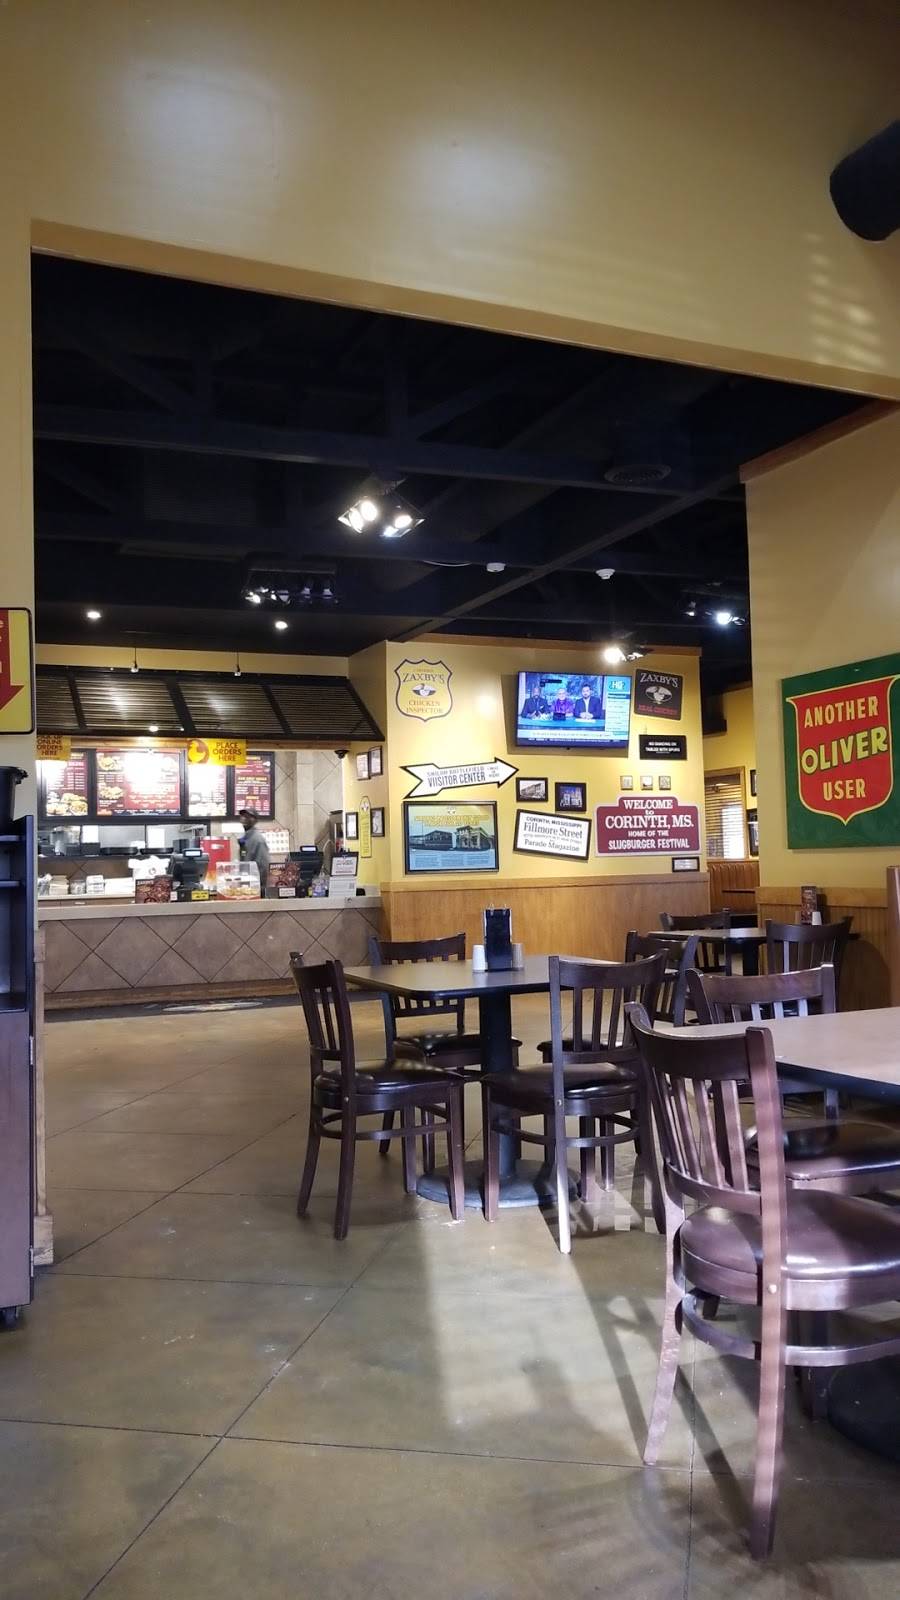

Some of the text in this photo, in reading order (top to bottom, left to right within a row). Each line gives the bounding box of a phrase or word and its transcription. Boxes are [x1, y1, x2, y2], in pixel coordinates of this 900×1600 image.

[403, 673, 445, 684] ZAXBY'S
[639, 672, 678, 688] ZAXBY'S
[804, 696, 879, 729] ANOTHER
[801, 726, 888, 774] OLIVER
[459, 771, 486, 784] CENTER
[823, 778, 866, 801] USER
[623, 799, 673, 810] WELCOME
[605, 814, 694, 829] CORINTH, MS.
[524, 822, 558, 835] Fillmore
[559, 827, 583, 839] Street
[548, 842, 580, 851] Magazine
[608, 838, 690, 850] SLUGBURGER FESTIVAL
